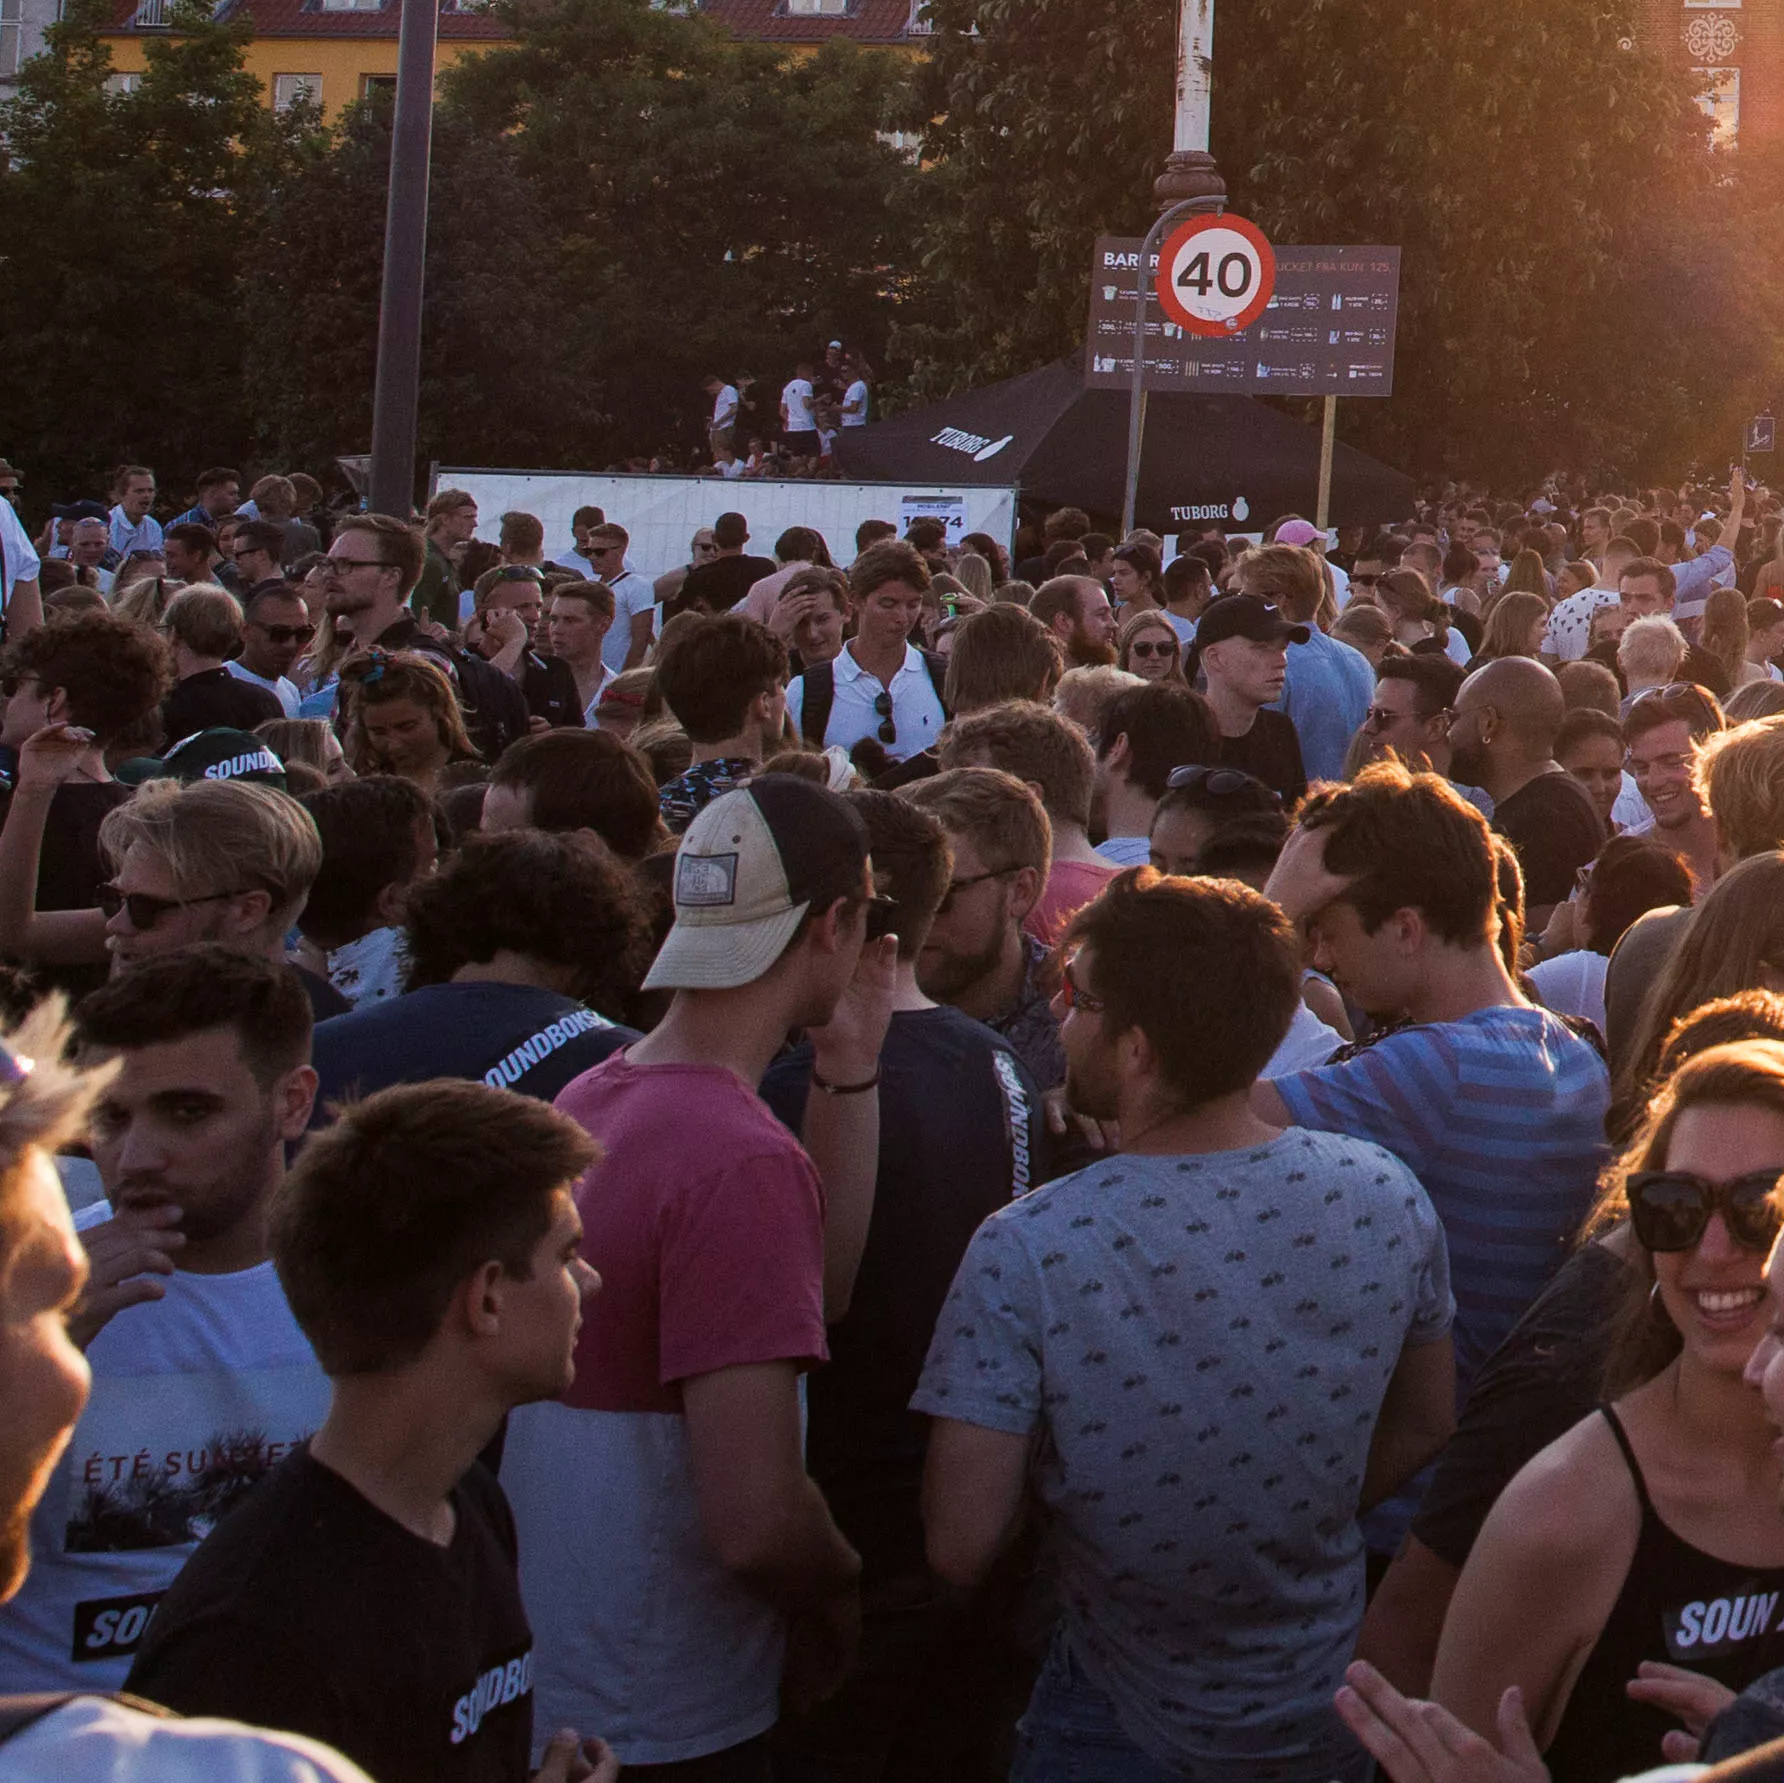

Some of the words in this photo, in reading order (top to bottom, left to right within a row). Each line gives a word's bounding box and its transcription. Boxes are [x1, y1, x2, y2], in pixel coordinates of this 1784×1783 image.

[1177, 252, 1252, 299] 40
[1275, 262, 1312, 272] UCKET
[929, 426, 991, 454] TUBORG
[1170, 503, 1229, 521] TUBORG
[476, 1009, 602, 1090] OUNDBOKS
[83, 1446, 152, 1484] ÉTÉ
[85, 1602, 159, 1648] SO
